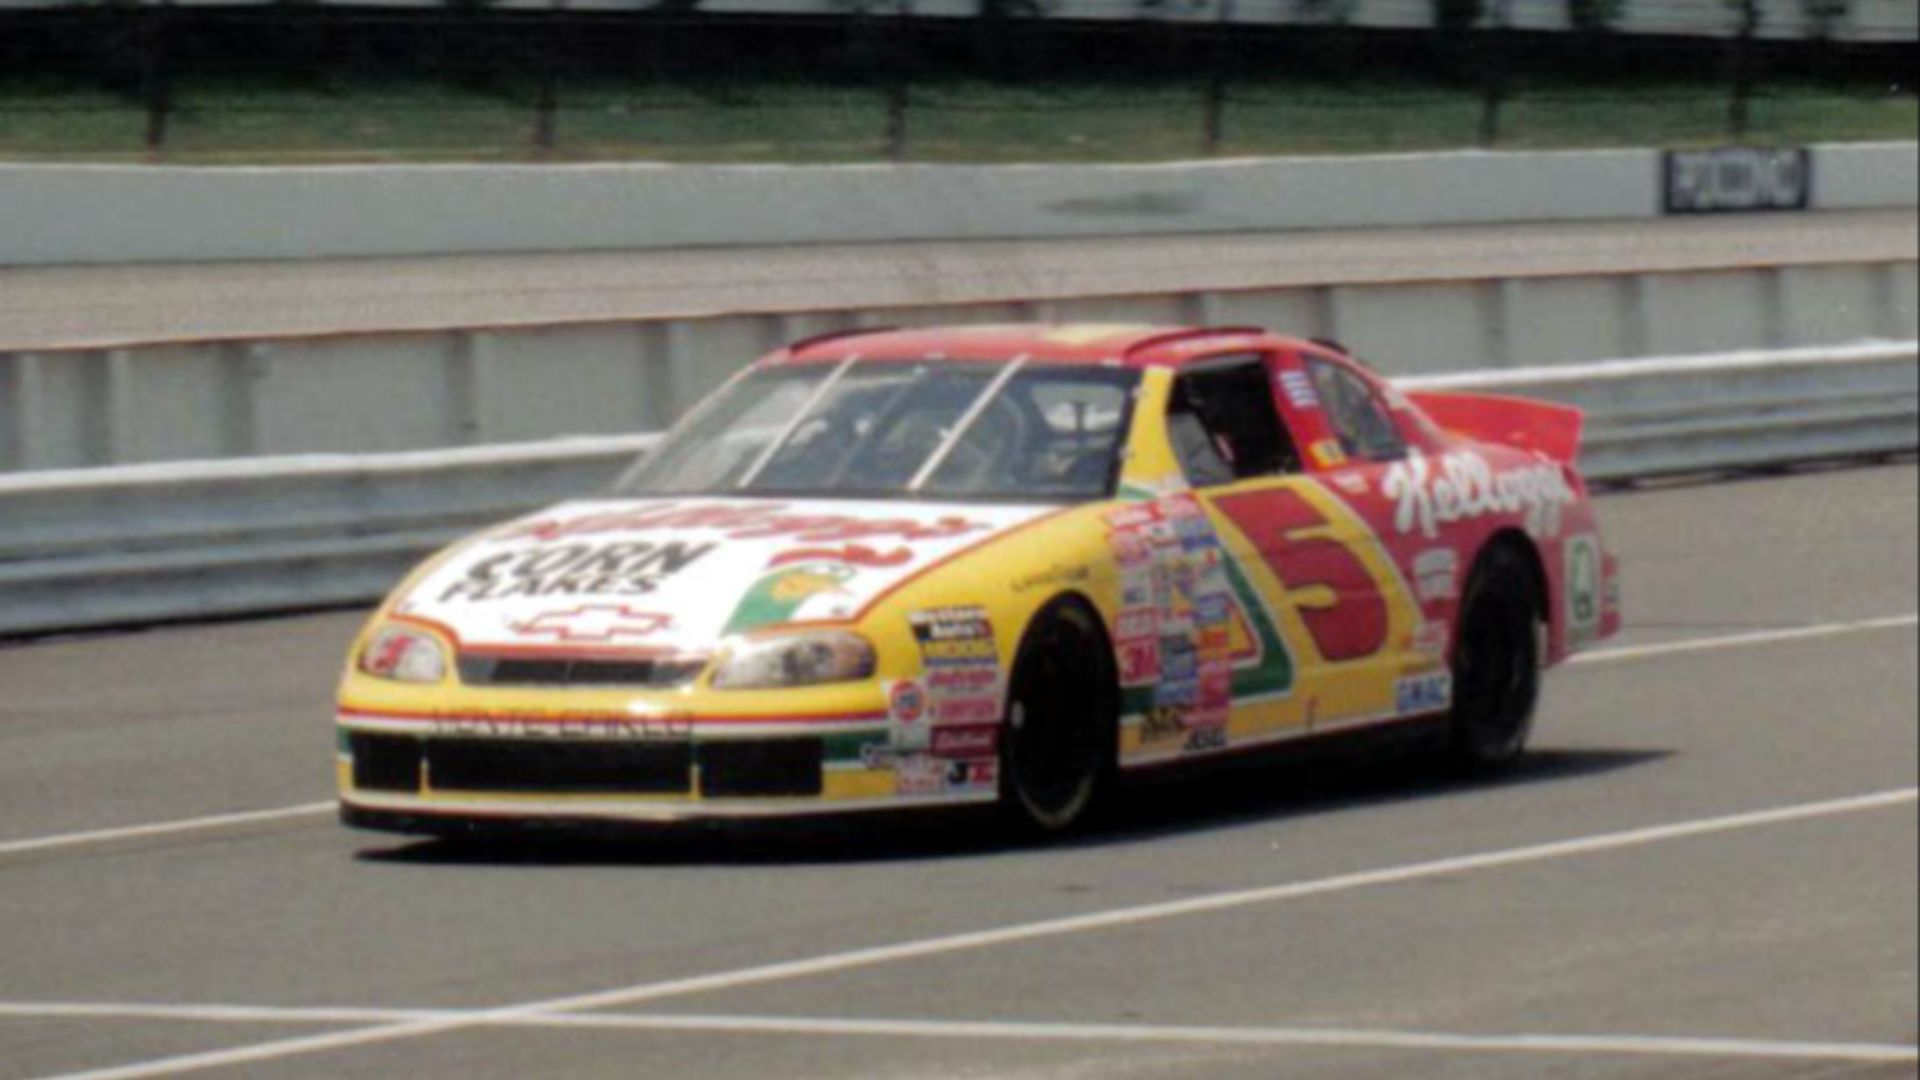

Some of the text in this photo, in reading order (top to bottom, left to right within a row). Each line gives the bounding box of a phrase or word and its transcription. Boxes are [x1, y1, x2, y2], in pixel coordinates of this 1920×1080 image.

[466, 541, 720, 581] CORN
[1215, 487, 1389, 662] 5
[436, 574, 660, 603] FLAKES
